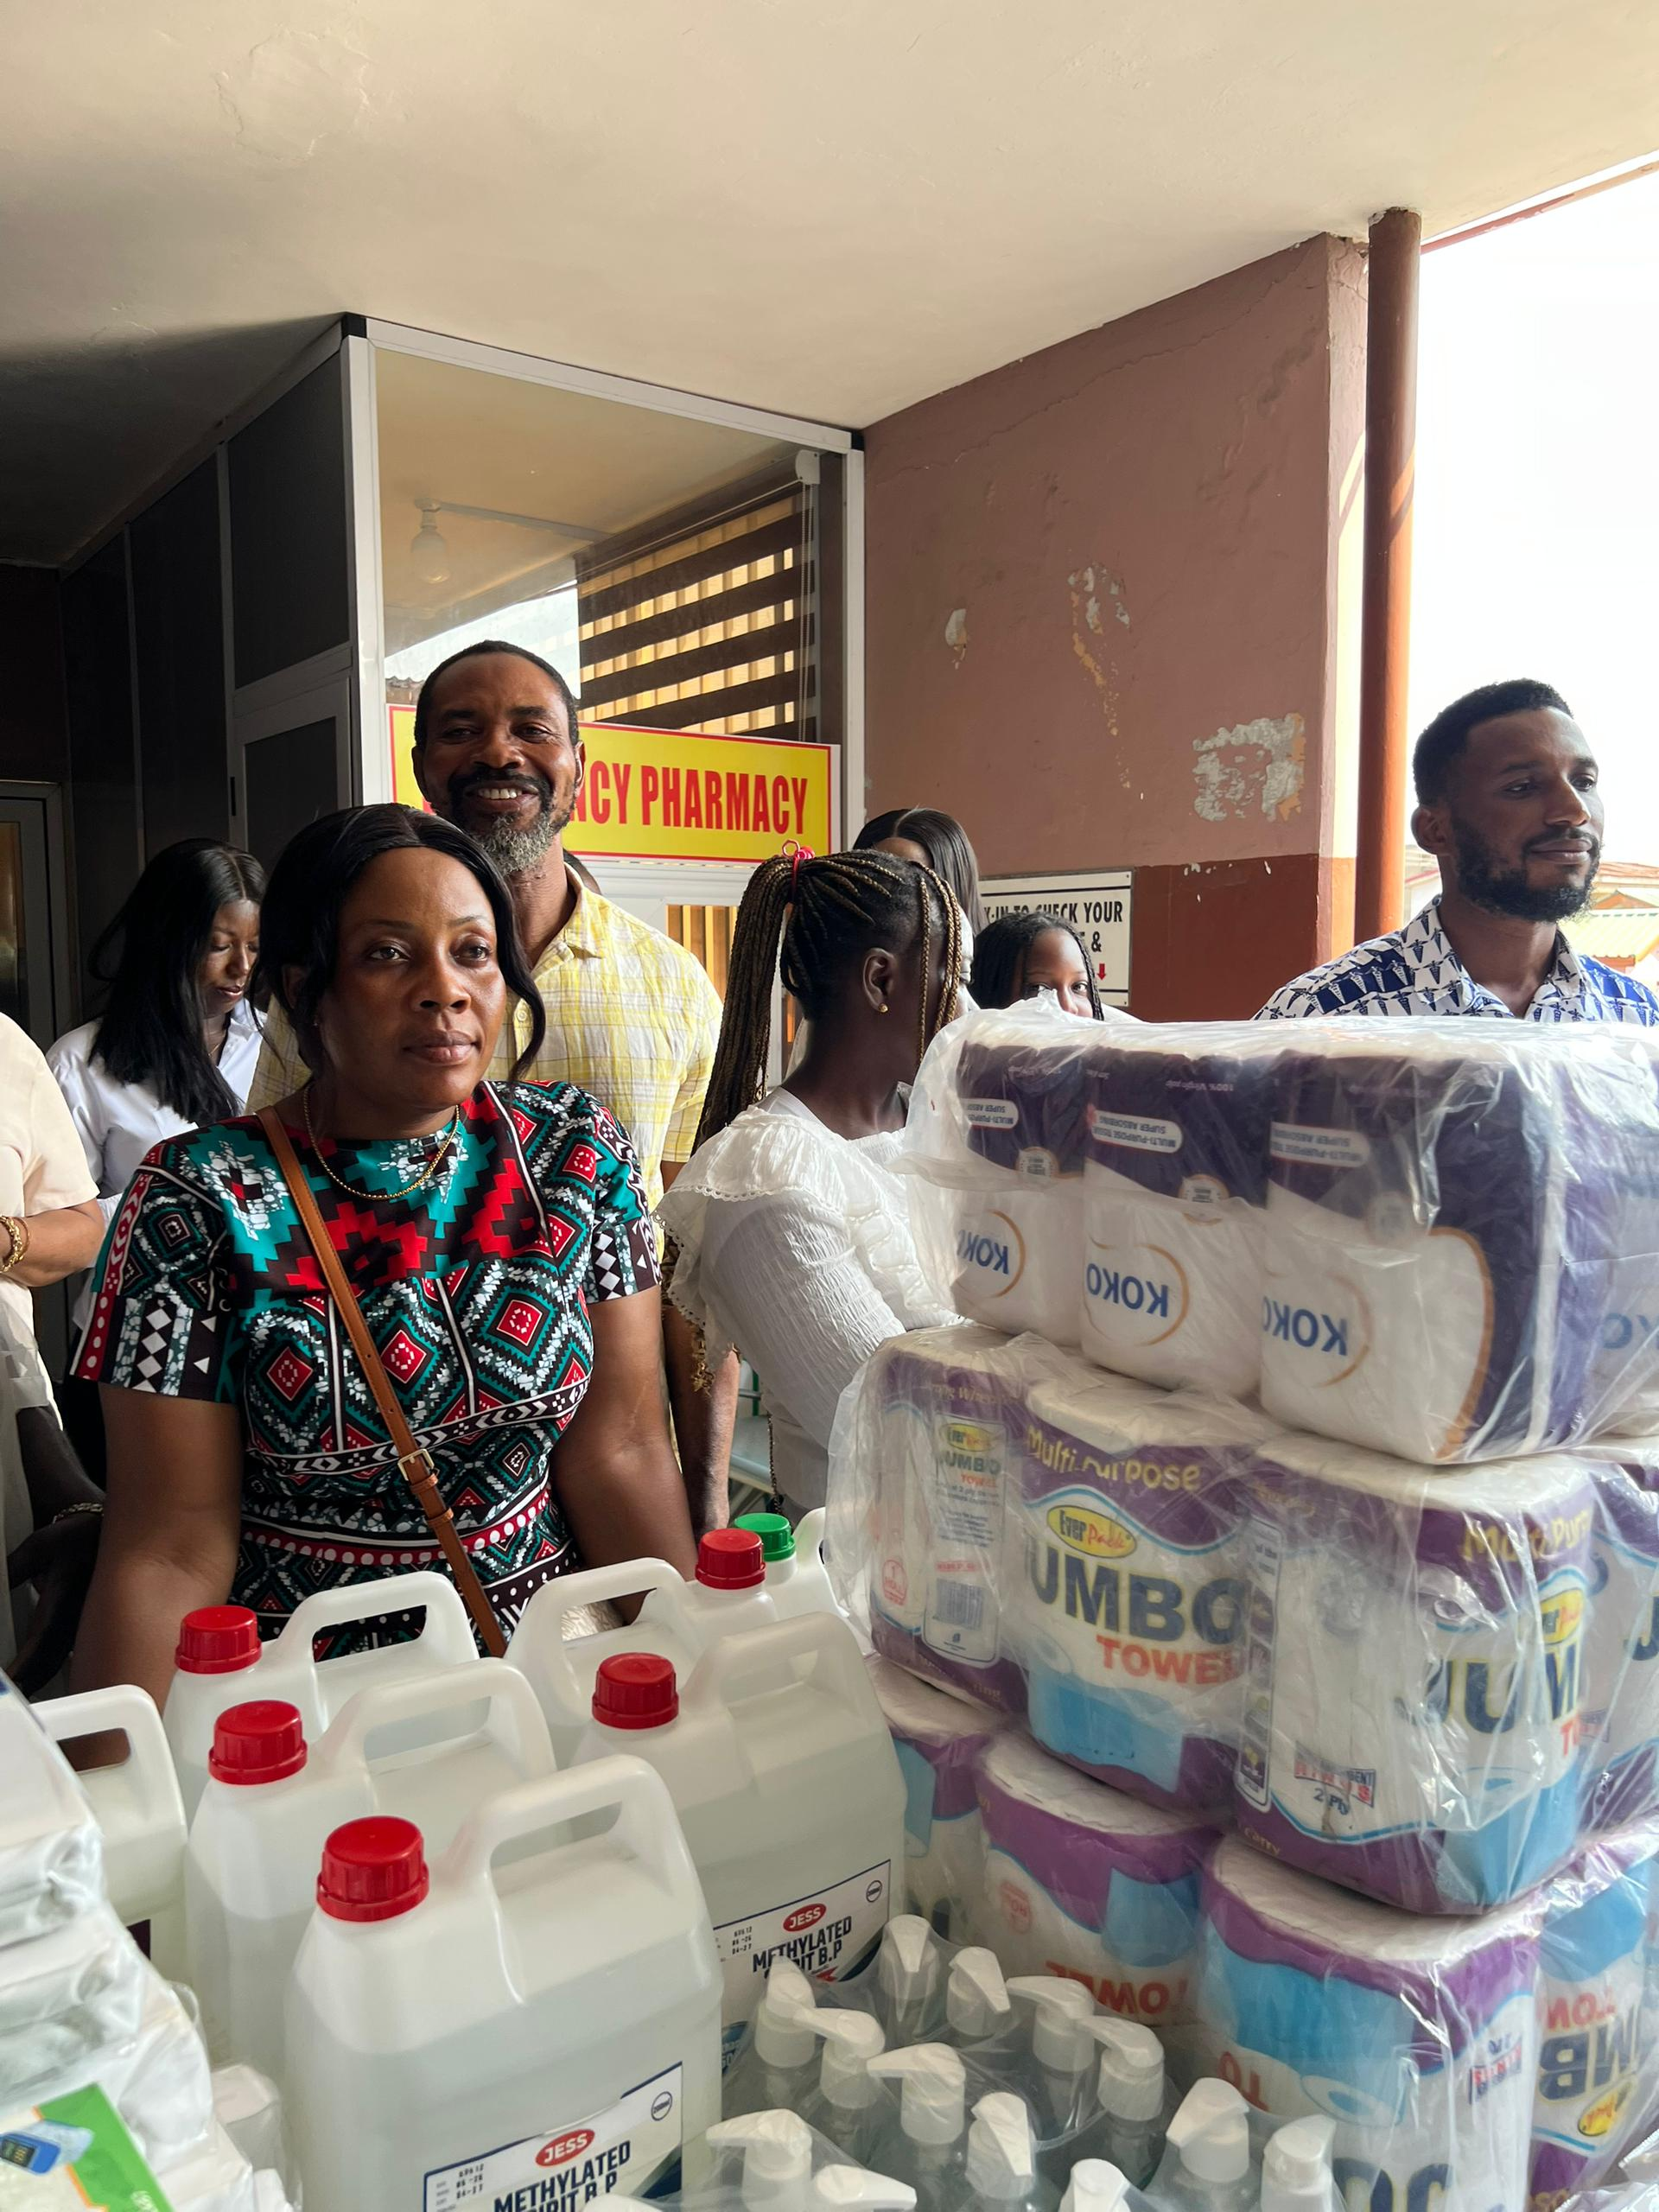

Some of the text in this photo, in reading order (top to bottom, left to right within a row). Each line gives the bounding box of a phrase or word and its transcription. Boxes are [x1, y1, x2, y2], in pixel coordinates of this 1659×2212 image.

[641, 765, 808, 836] PHARMACY
[1084, 900, 1122, 924] YOUR
[1086, 1262, 1169, 1319] KOKO
[1030, 1545, 1246, 1646] UMBO
[753, 1915, 852, 1974] METHYLATED
[789, 1906, 822, 1929] JESS
[818, 1939, 842, 1967] B.P
[493, 2139, 632, 2212] METHYLATED
[543, 2133, 588, 2164] JESS
